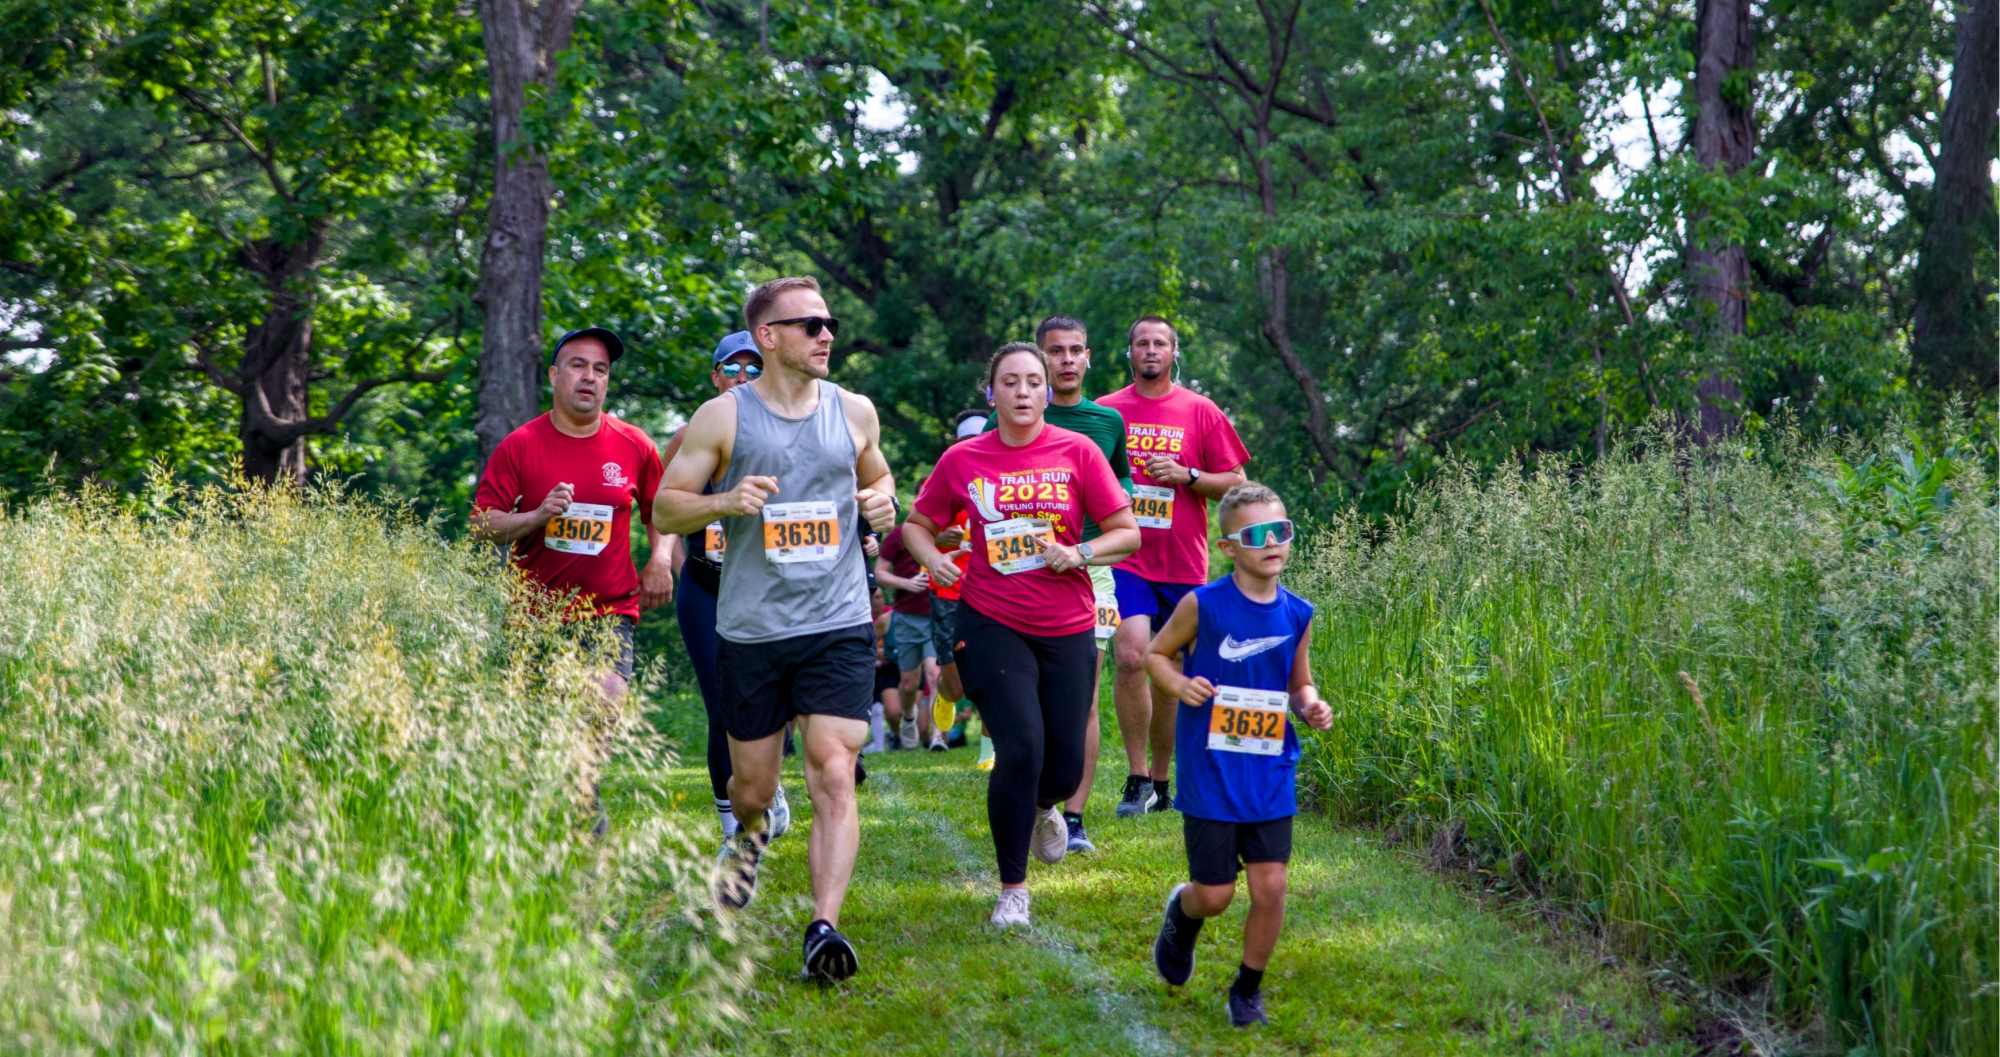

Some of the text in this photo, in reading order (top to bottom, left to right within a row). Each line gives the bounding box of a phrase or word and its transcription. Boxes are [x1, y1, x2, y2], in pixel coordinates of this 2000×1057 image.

[1129, 427, 1185, 439] TRAIL RUN
[1126, 435, 1182, 452] 2025
[1126, 450, 1148, 458] FUELIN
[1133, 457, 1146, 466] On
[1000, 472, 1071, 485] TRAIL RUN
[969, 484, 981, 505] WCC
[999, 482, 1069, 501] 2025
[1000, 502, 1070, 511] FUELING FUTURES
[1037, 510, 1062, 522] Step
[553, 517, 605, 542] 3502
[774, 521, 830, 547] 3630
[1097, 607, 1117, 627] 82
[1220, 708, 1279, 738] 3632
